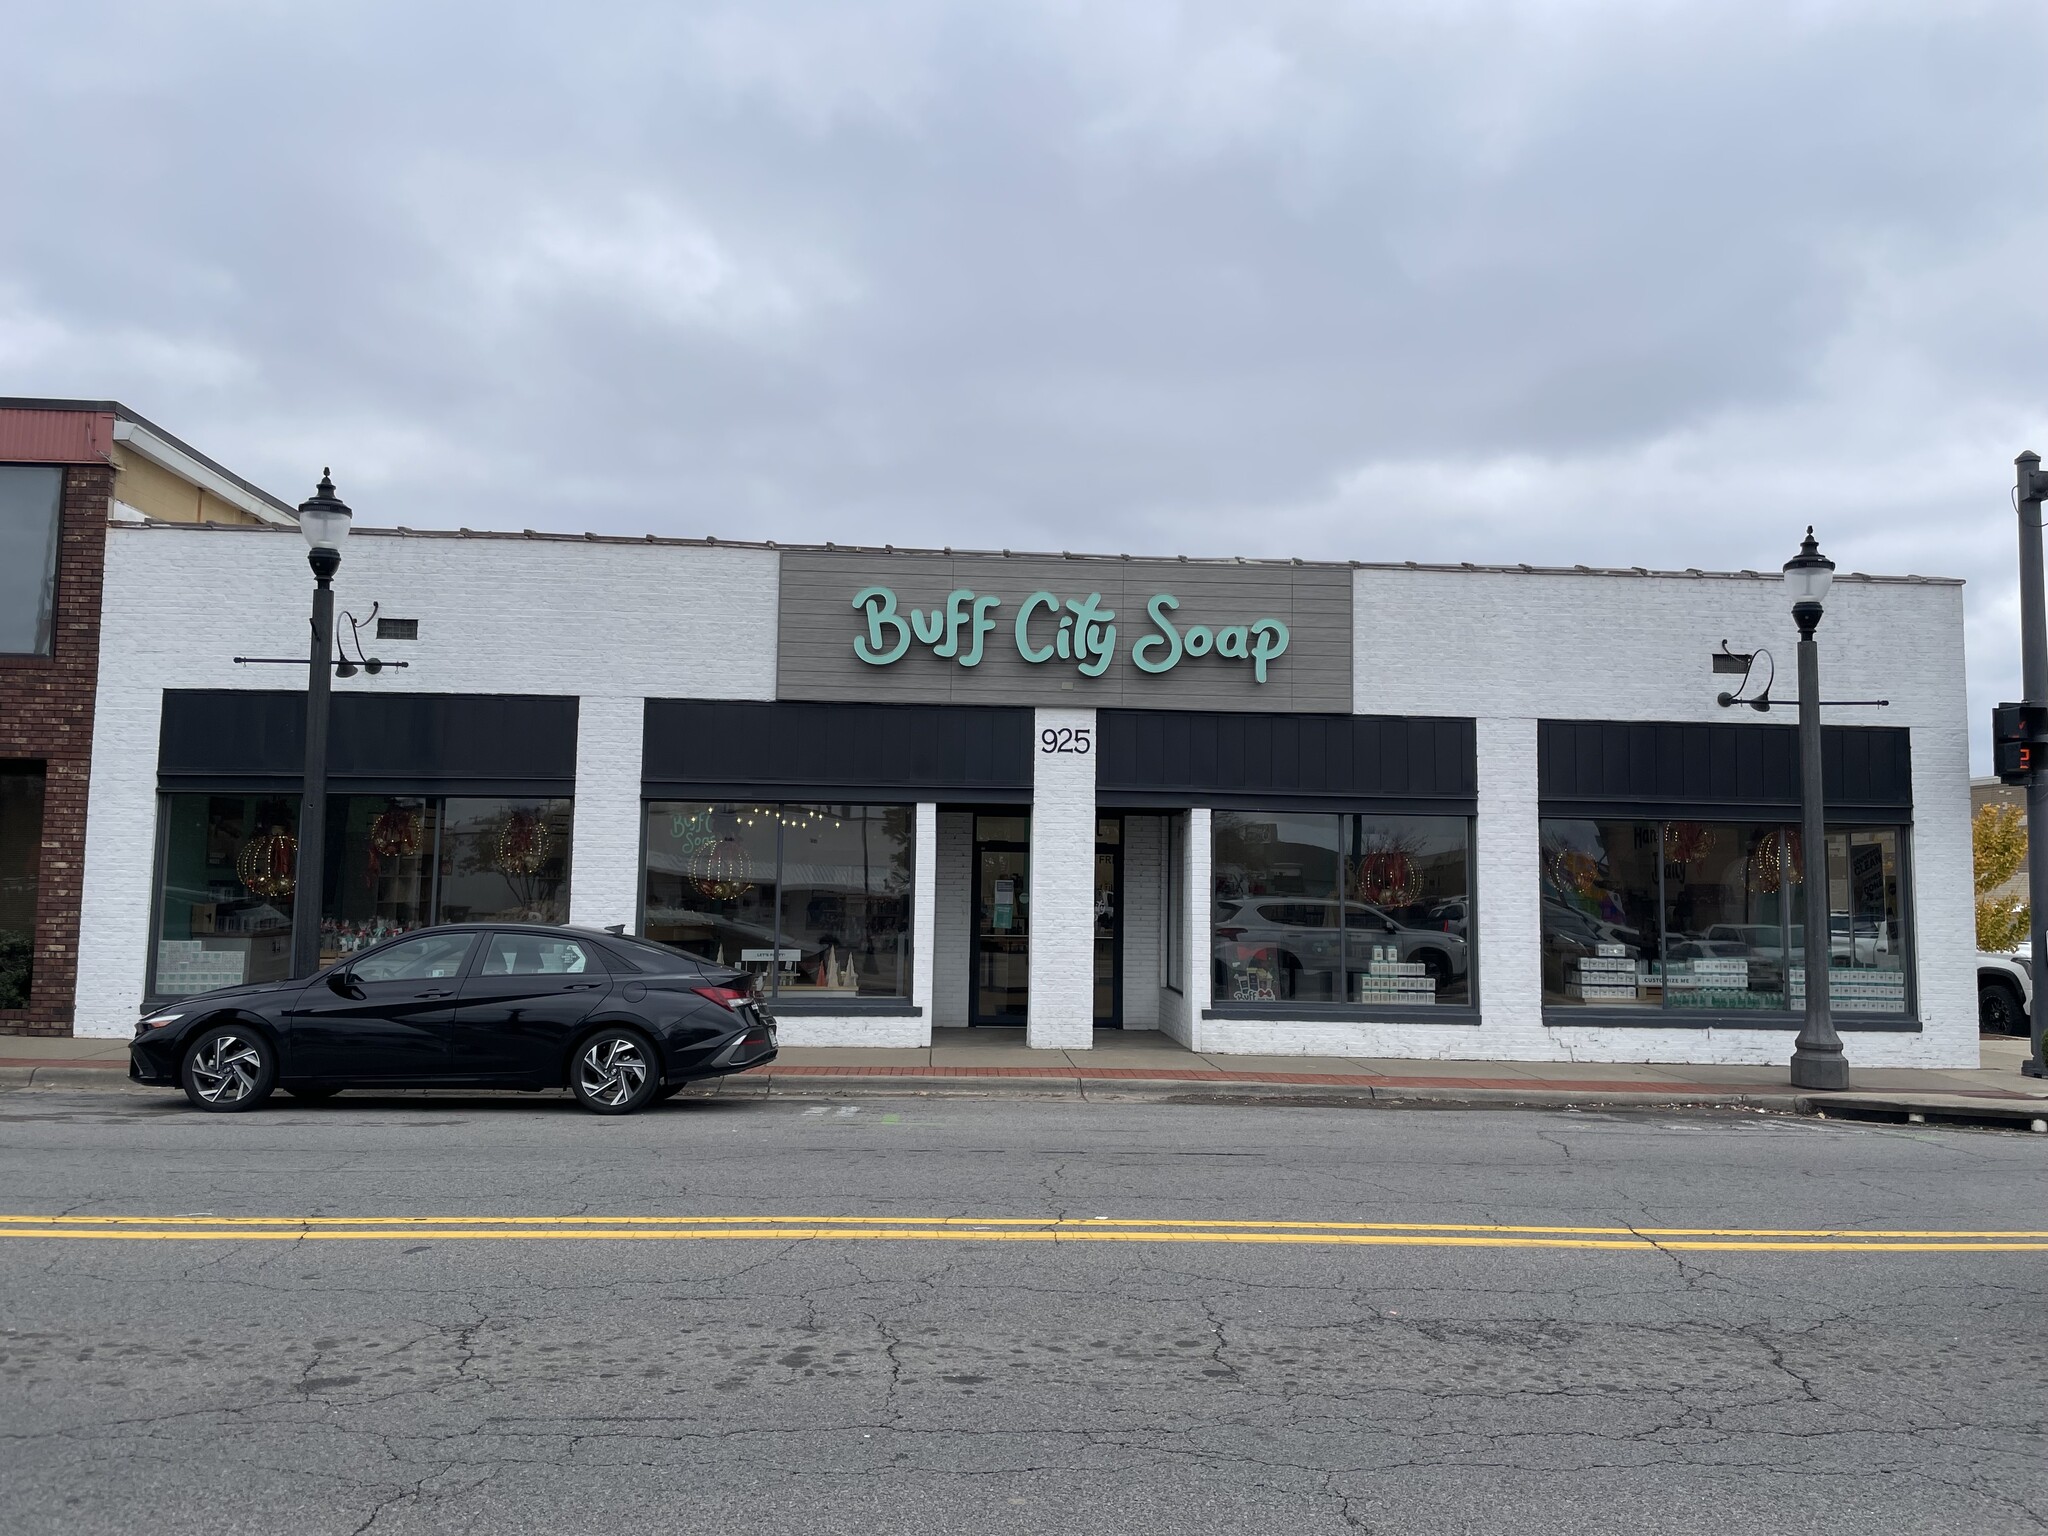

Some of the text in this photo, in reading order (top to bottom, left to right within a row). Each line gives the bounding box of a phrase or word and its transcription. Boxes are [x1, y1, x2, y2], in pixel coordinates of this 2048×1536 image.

[852, 586, 1290, 684] Buff City Soap
[1041, 728, 1090, 754] 925
